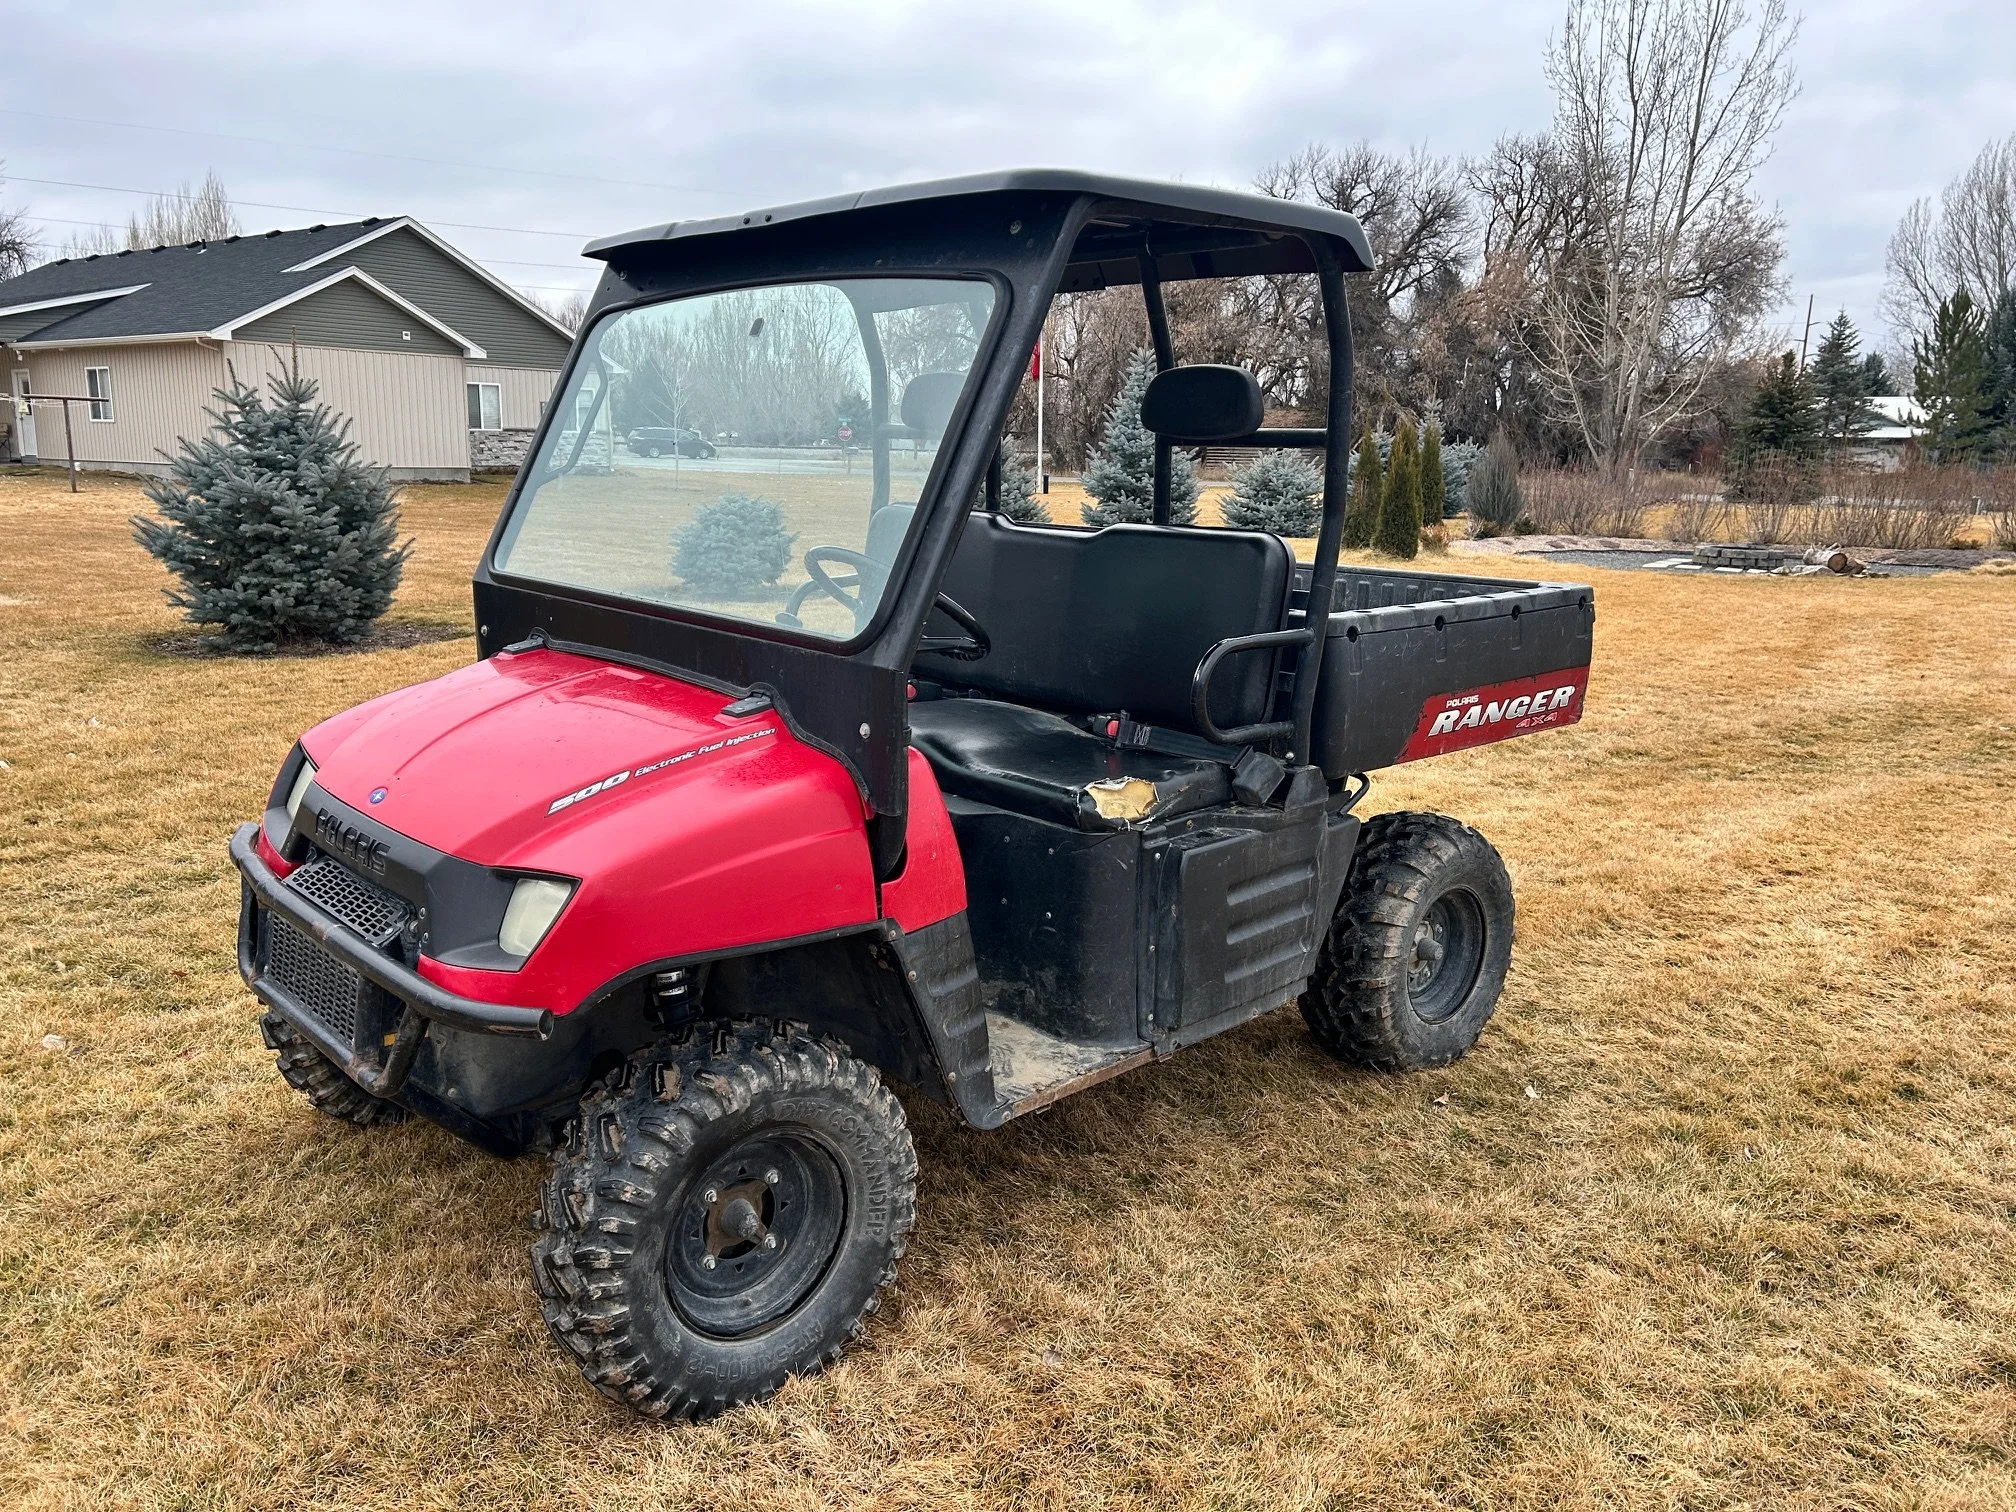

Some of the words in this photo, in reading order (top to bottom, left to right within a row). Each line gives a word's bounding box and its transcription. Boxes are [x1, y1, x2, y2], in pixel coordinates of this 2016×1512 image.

[1427, 685, 1576, 737] RANGER
[1446, 695, 1479, 708] POLARIS
[547, 770, 631, 815] 500
[634, 750, 696, 777] Electronic
[698, 741, 725, 755] Fuel
[725, 728, 776, 746] Injection
[315, 807, 391, 876] POLARIS
[828, 1107, 887, 1238] COMMANDER
